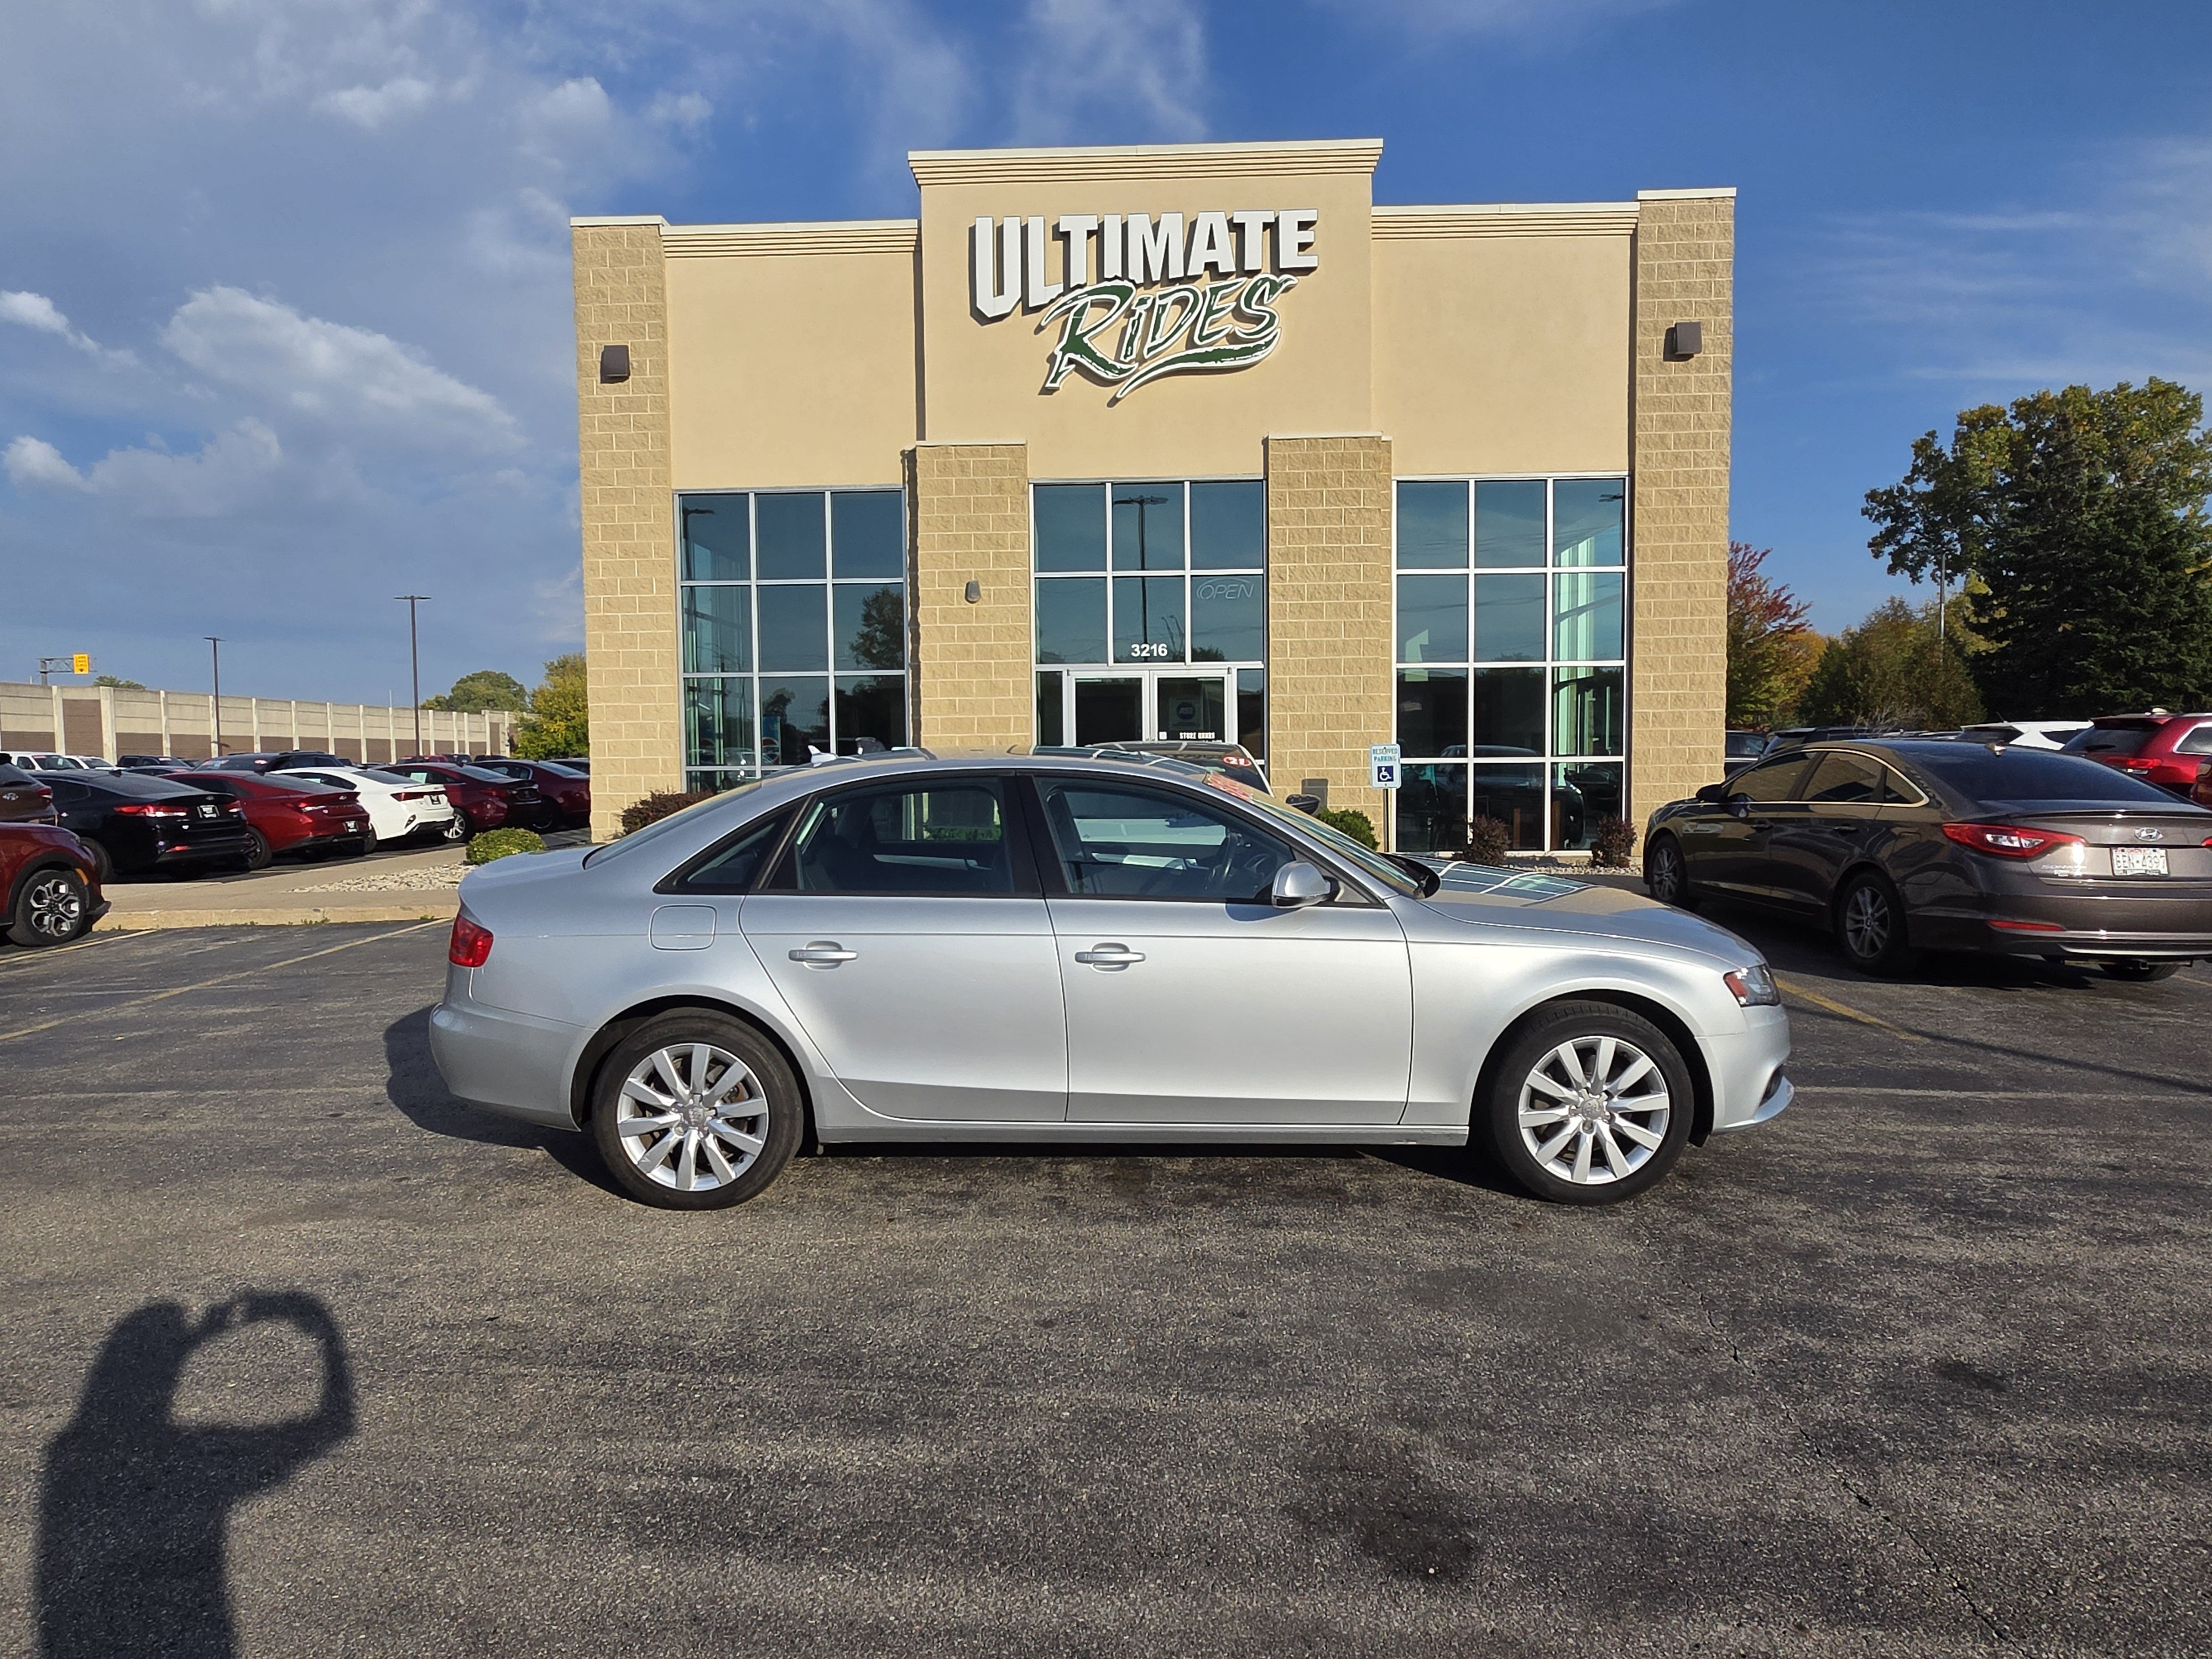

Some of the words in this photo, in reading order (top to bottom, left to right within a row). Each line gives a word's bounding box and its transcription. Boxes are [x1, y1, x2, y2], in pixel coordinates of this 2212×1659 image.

[974, 208, 1318, 319] ULTIMATE
[1199, 583, 1254, 599] OPEN
[1131, 643, 1168, 657] 3216
